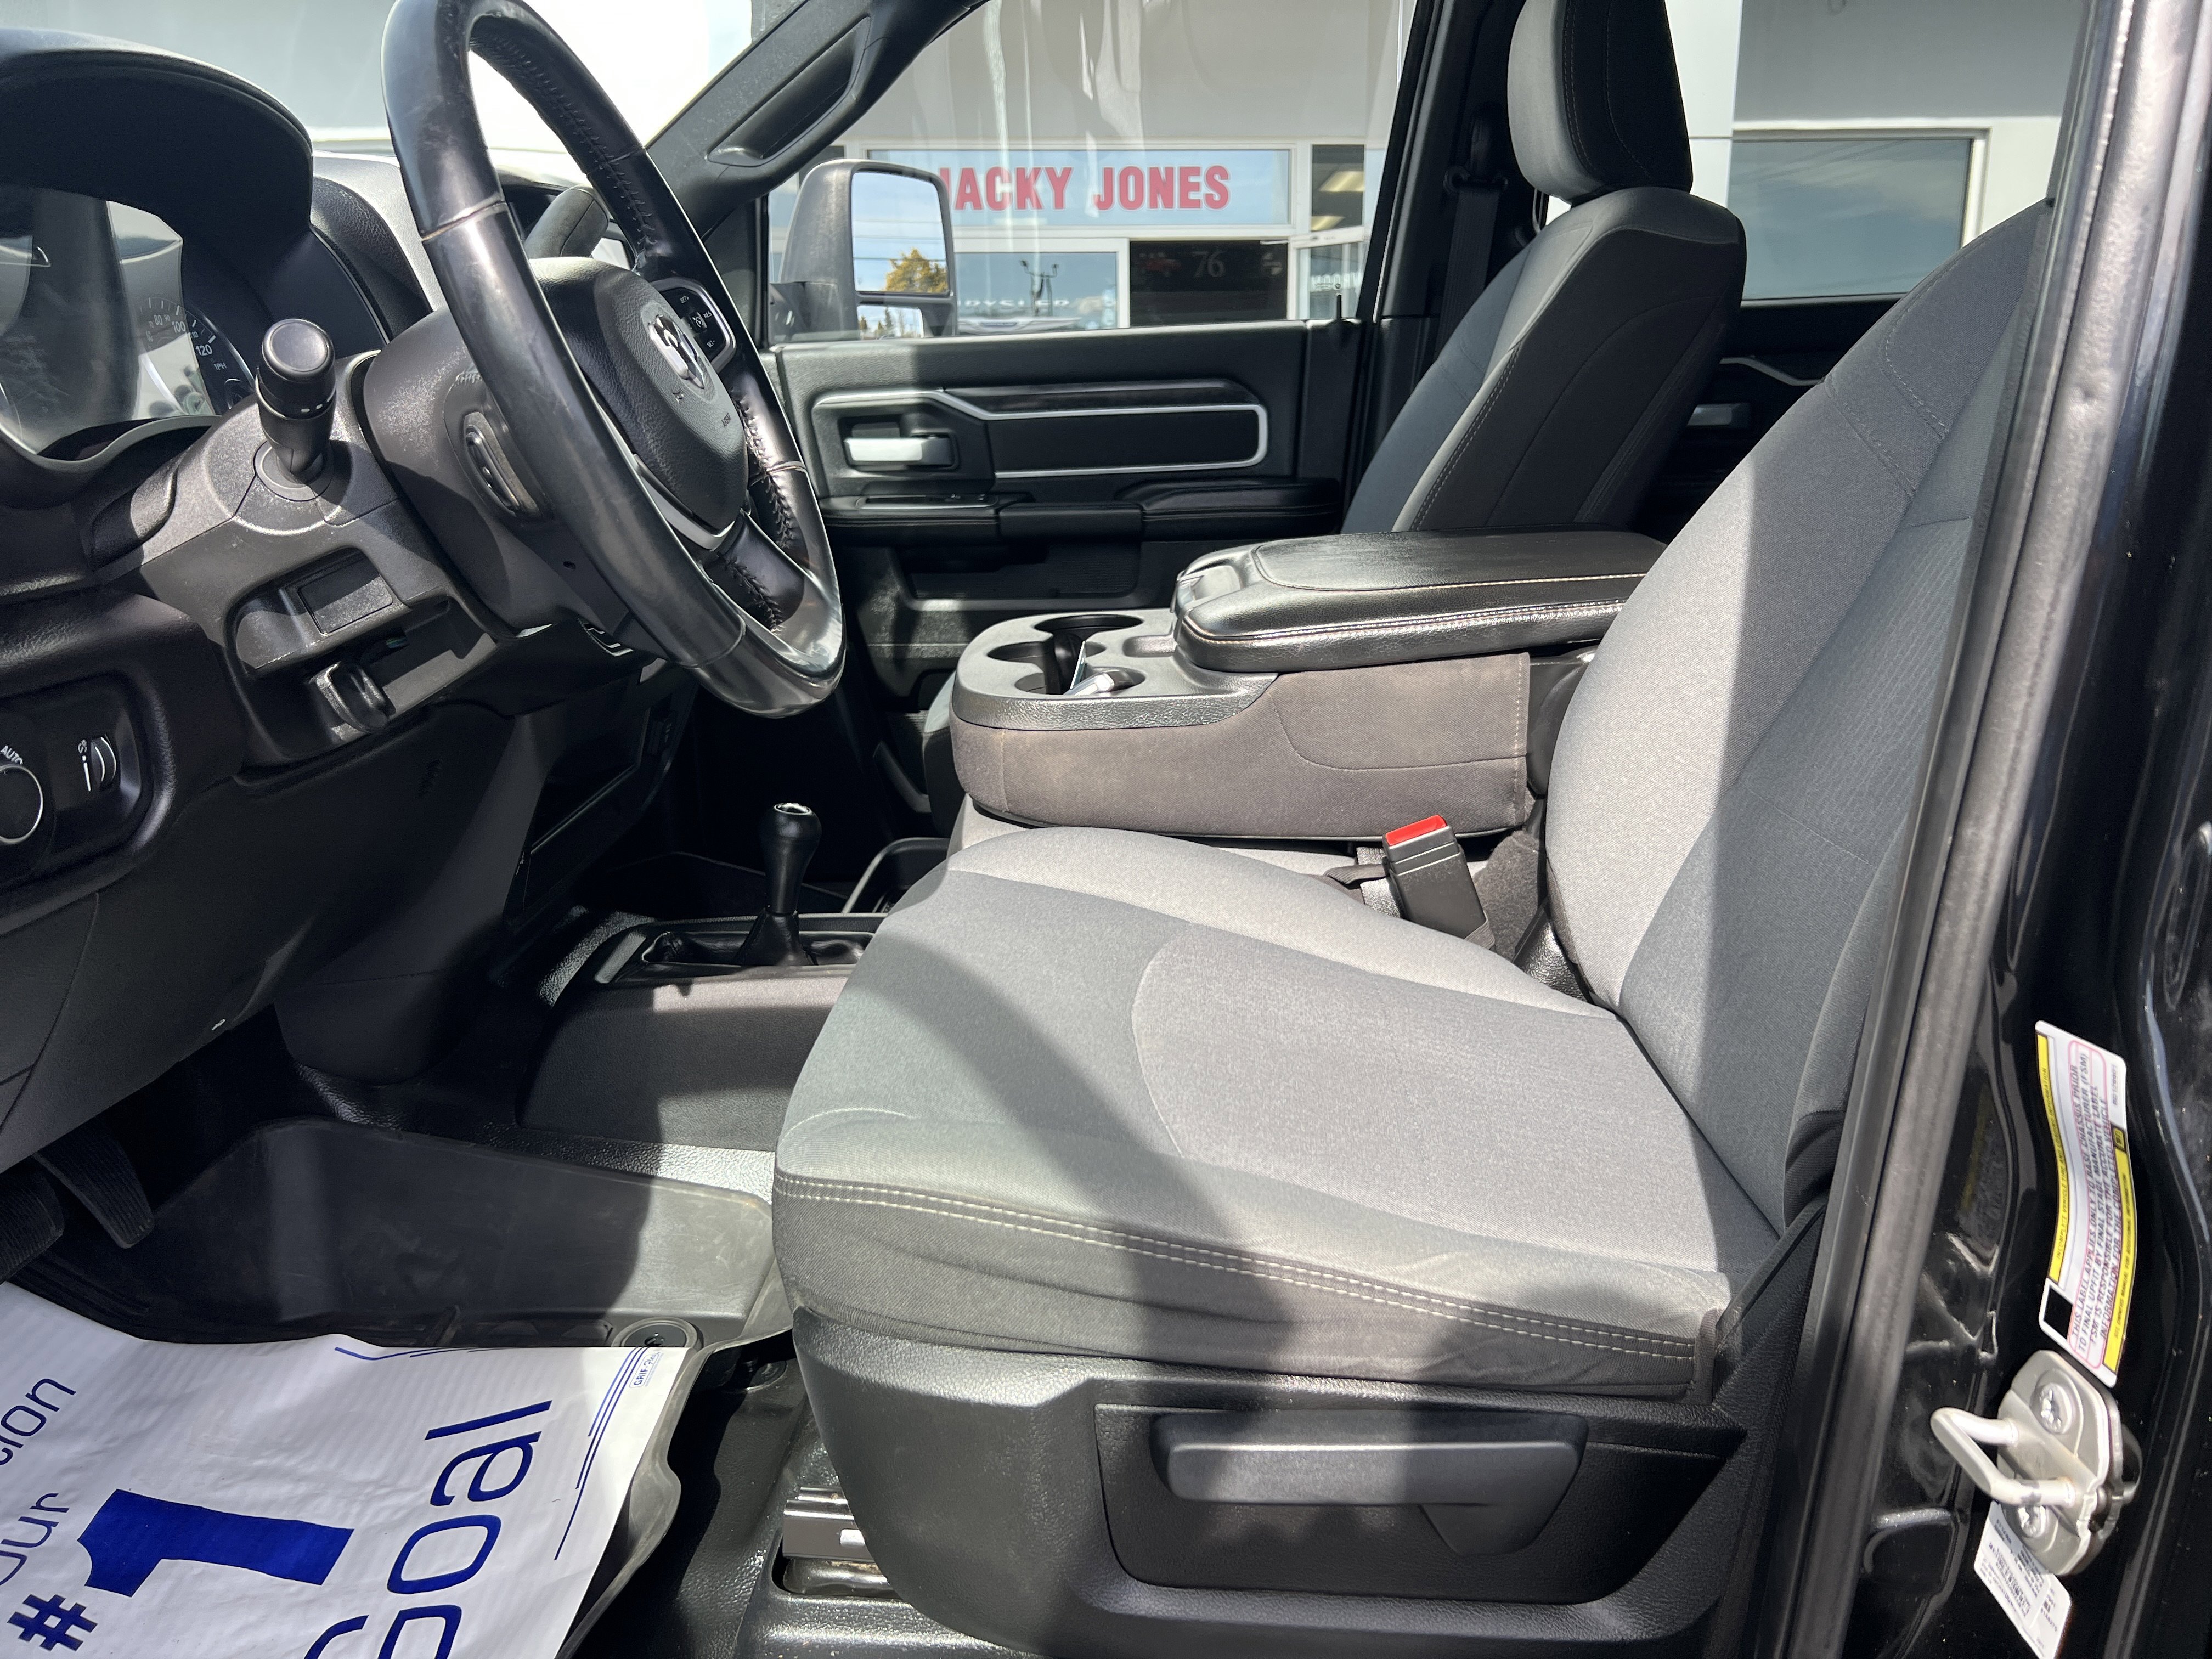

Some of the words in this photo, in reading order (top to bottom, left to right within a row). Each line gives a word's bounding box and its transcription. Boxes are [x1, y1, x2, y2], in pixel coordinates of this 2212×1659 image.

[1093, 166, 1229, 211] JONES
[154, 314, 163, 325] 80
[172, 321, 185, 332] 100
[195, 344, 212, 356] 120
[1, 746, 22, 764] AUTO
[2069, 1065, 2080, 1099] PRIOR
[2079, 1053, 2089, 1085] (FSM)
[2090, 1085, 2100, 1119] LABEL
[2074, 1101, 2087, 1147] CHASSIS
[2081, 1088, 2101, 1176] MANUFACTURER
[2100, 1098, 2111, 1142] VEHICLE
[2083, 1152, 2093, 1178] BASE
[2094, 1122, 2108, 1177] ACCURATE
[2088, 1180, 2095, 1193] TO
[2106, 1146, 2121, 1211] COMPLETED
[2095, 1180, 2104, 1214] STAGE
[2056, 1215, 2067, 1260] INCOMPLETE
[2113, 1212, 2121, 1234] THE
[2085, 1229, 2096, 1274] APPLIES
[2095, 1250, 2102, 1266] BY
[2113, 1237, 2121, 1261] FOR
[2097, 1229, 2112, 1303] RESPONSIBLE
[2076, 1278, 2089, 1310] LABEL
[2088, 1269, 2099, 1301] UPFIT
[2094, 1306, 2102, 1317] IS
[2100, 1263, 2118, 1340] INFORMATION
[2072, 1312, 2082, 1338] THIS
[2081, 1305, 2094, 1335] FINAL
[2089, 1319, 2098, 1344] FSM
[2078, 1336, 2087, 1353] TO
[0, 1378, 76, 1465] ion
[7, 1489, 354, 1651] #1
